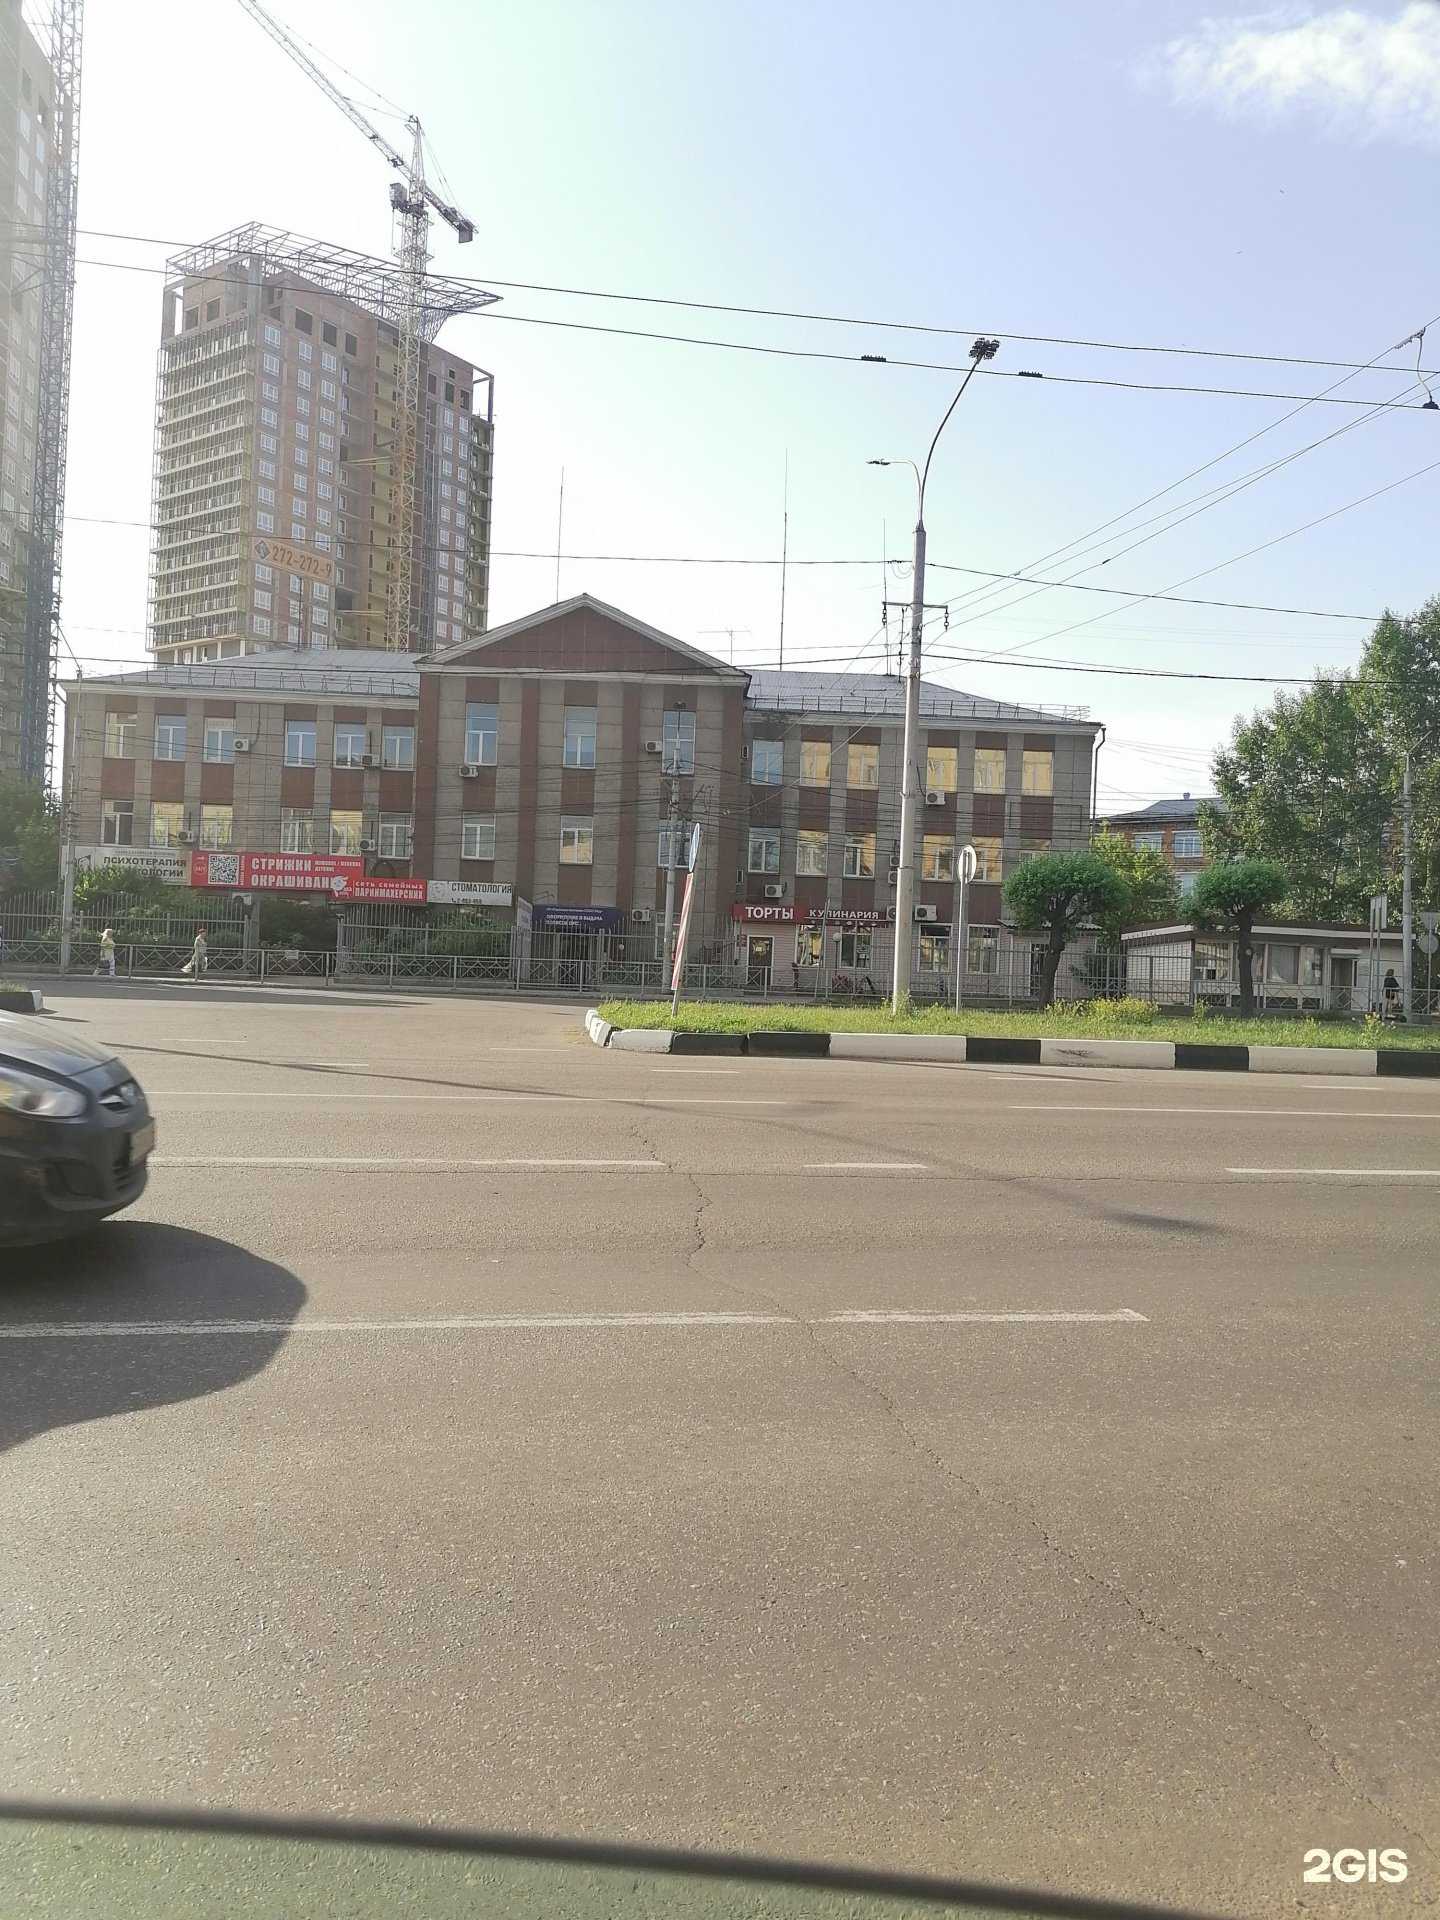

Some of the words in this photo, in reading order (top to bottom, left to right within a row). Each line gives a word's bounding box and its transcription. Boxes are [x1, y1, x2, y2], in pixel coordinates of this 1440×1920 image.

[103, 856, 187, 868] ПСИХОТЕРАПИЯ
[251, 857, 311, 872] СТРИЖКИ
[251, 874, 333, 889] ОКРАШИВАН
[451, 882, 512, 895] СТОМАТОЛОГИЯ
[745, 906, 794, 920] ТОРТЫ
